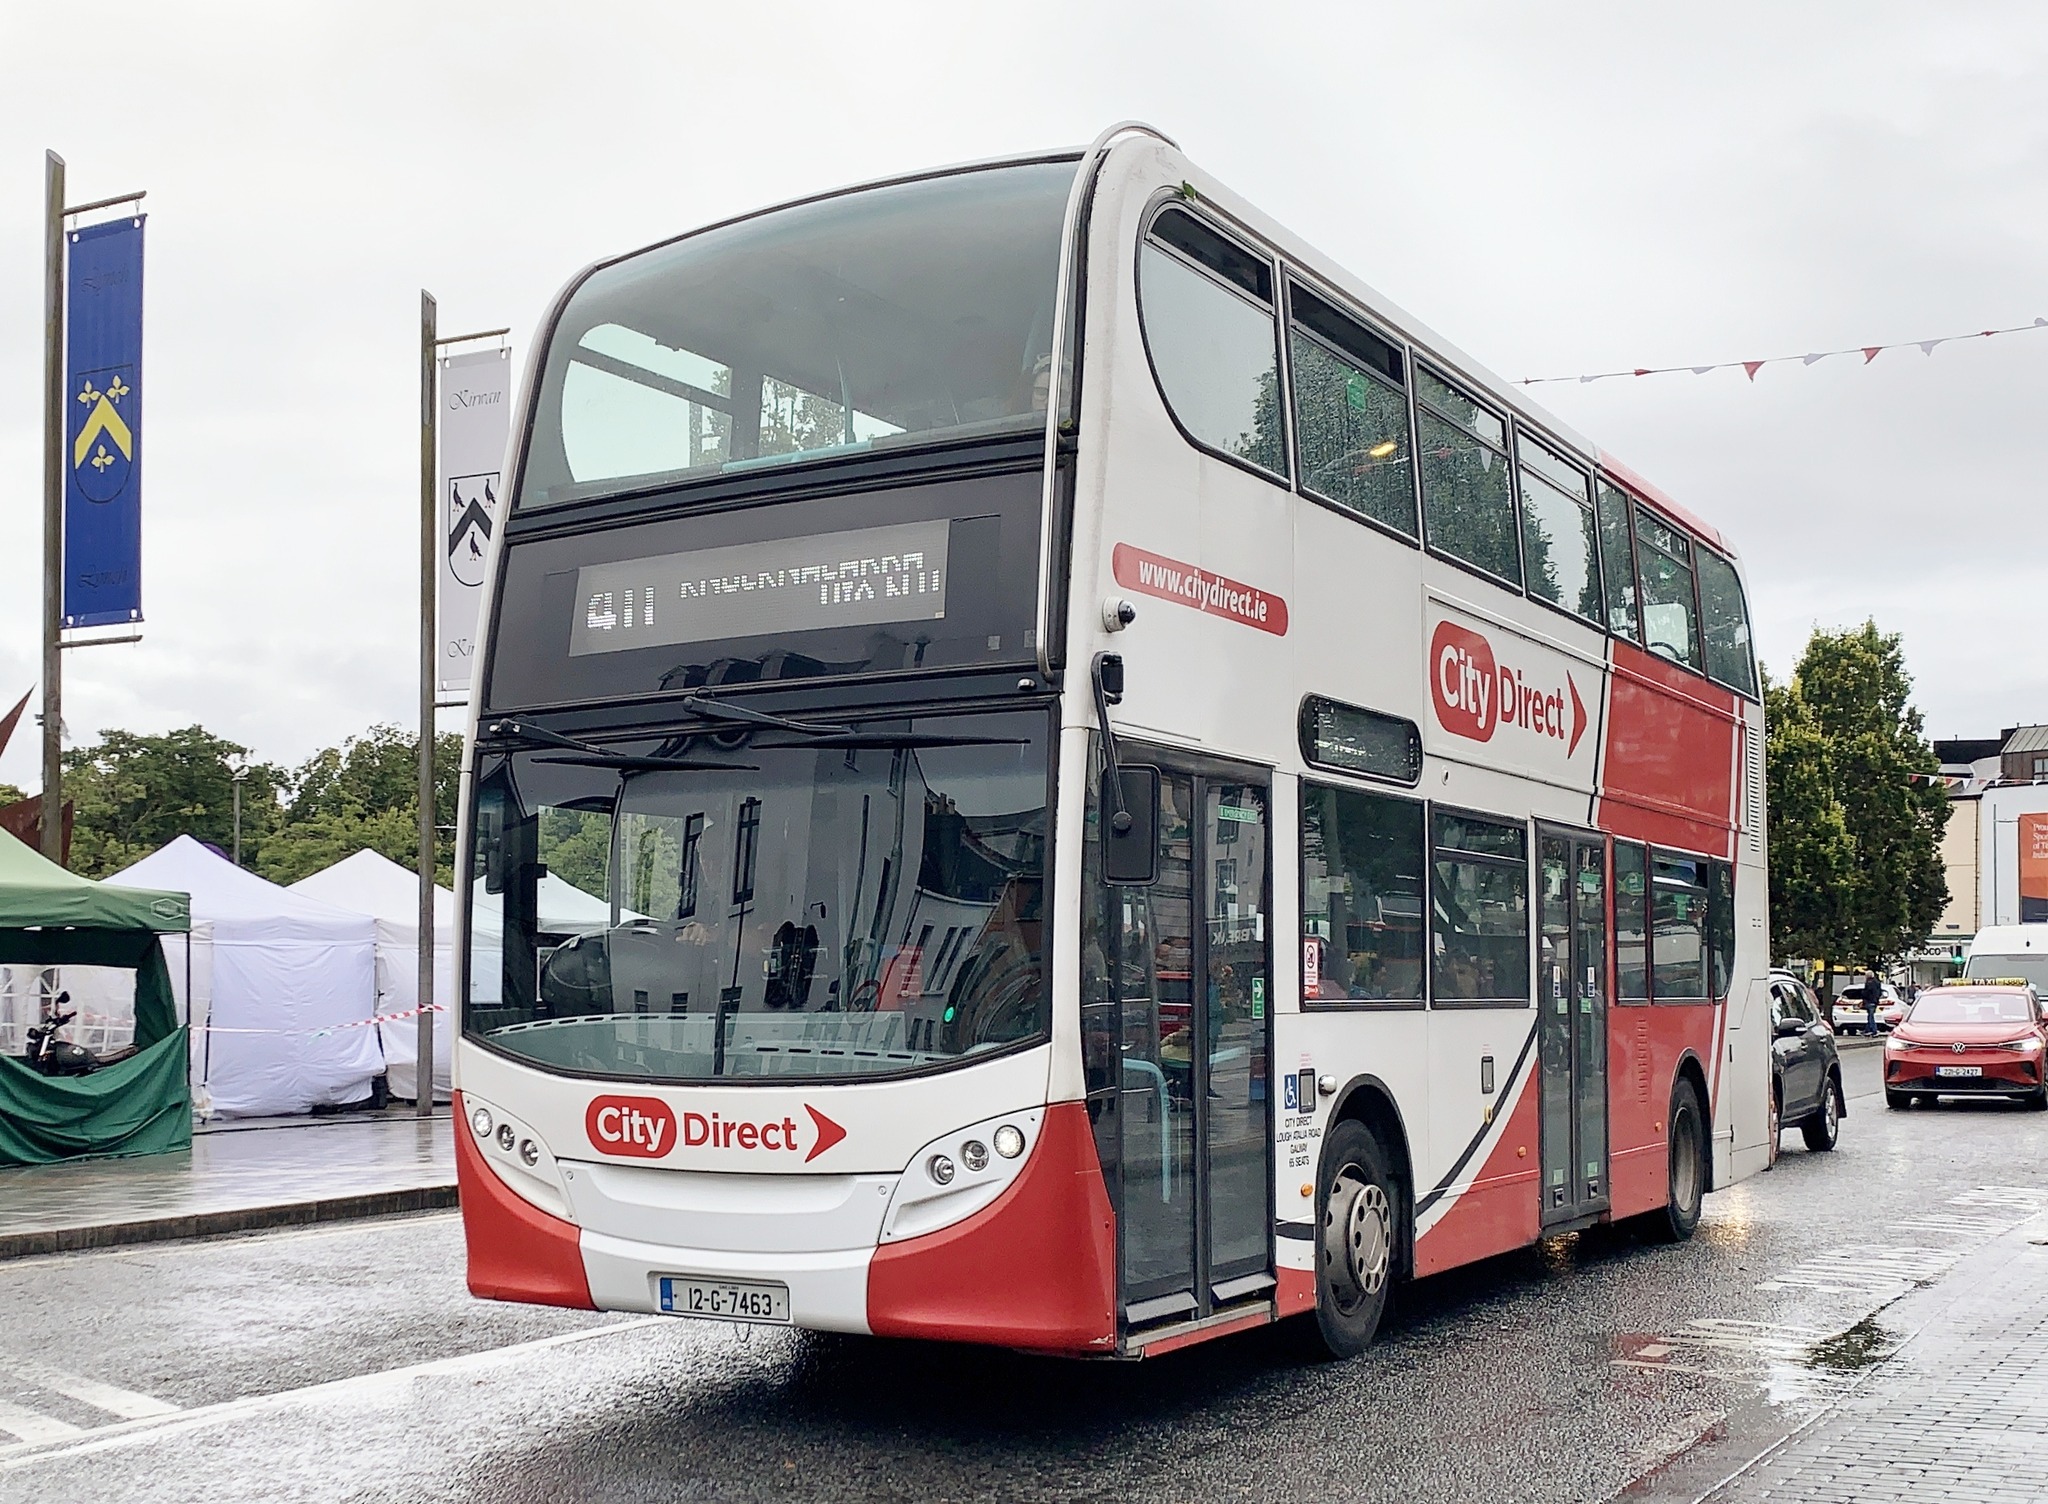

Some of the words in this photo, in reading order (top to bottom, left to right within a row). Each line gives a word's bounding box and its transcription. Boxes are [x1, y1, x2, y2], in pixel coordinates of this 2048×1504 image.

[449, 389, 502, 411] Kirwan
[1138, 560, 1268, 622] www.citydirect.ie
[1439, 644, 1491, 730] City
[1500, 665, 1564, 740] Direct
[1973, 978, 1996, 986] TAXI
[596, 1106, 666, 1152] City
[683, 1112, 798, 1151] Direct
[1285, 1118, 1296, 1129] CITY
[1297, 1115, 1312, 1127] DIRECT
[1276, 1132, 1292, 1143] LOUGH
[1290, 1142, 1308, 1154] GALWAY
[1295, 1155, 1310, 1167] SEATS
[688, 1287, 772, 1316] 12-G-7463
